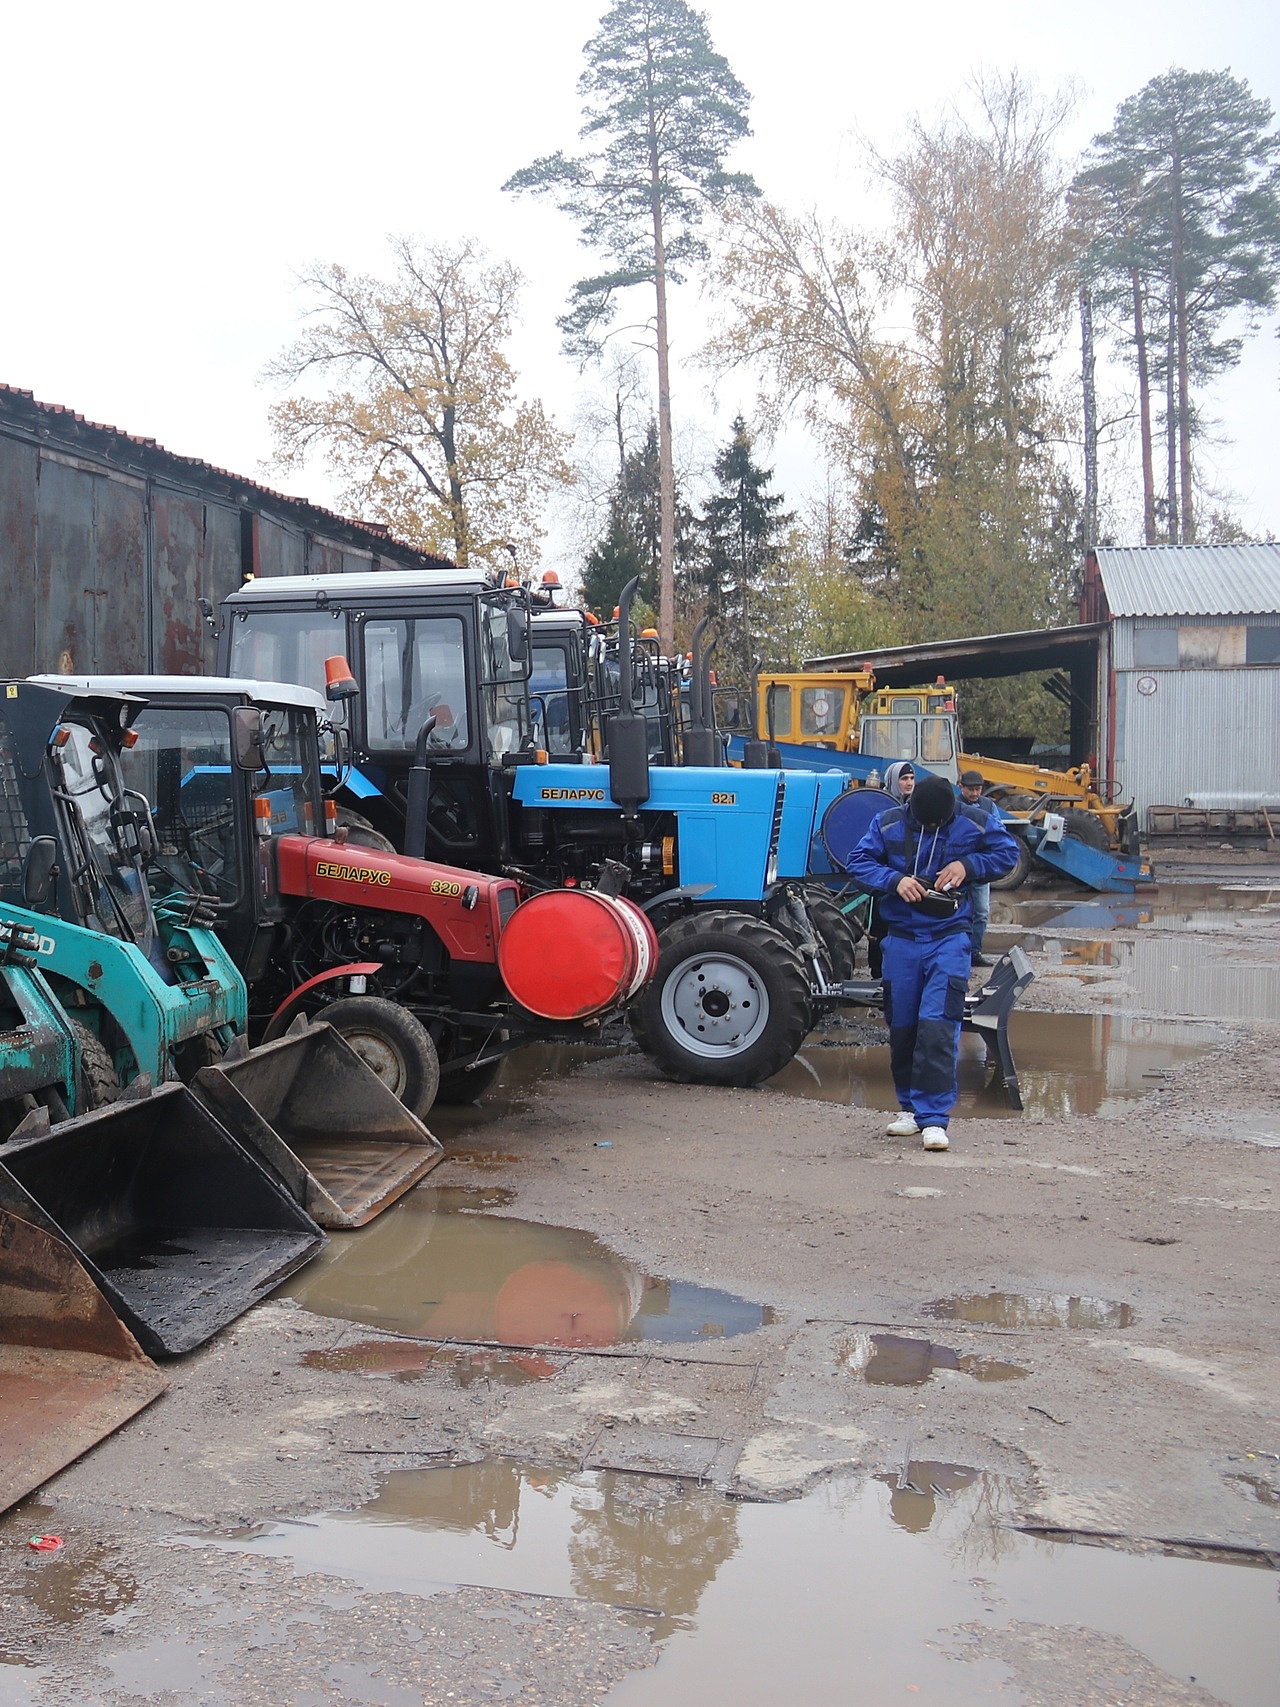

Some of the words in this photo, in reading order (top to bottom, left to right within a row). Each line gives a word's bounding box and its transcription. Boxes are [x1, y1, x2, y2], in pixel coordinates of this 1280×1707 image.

[540, 787, 606, 801] БЕЛАРУС
[711, 792, 736, 805] 82.1
[316, 862, 391, 886] БЕЛАРУС
[430, 879, 461, 896] 320
